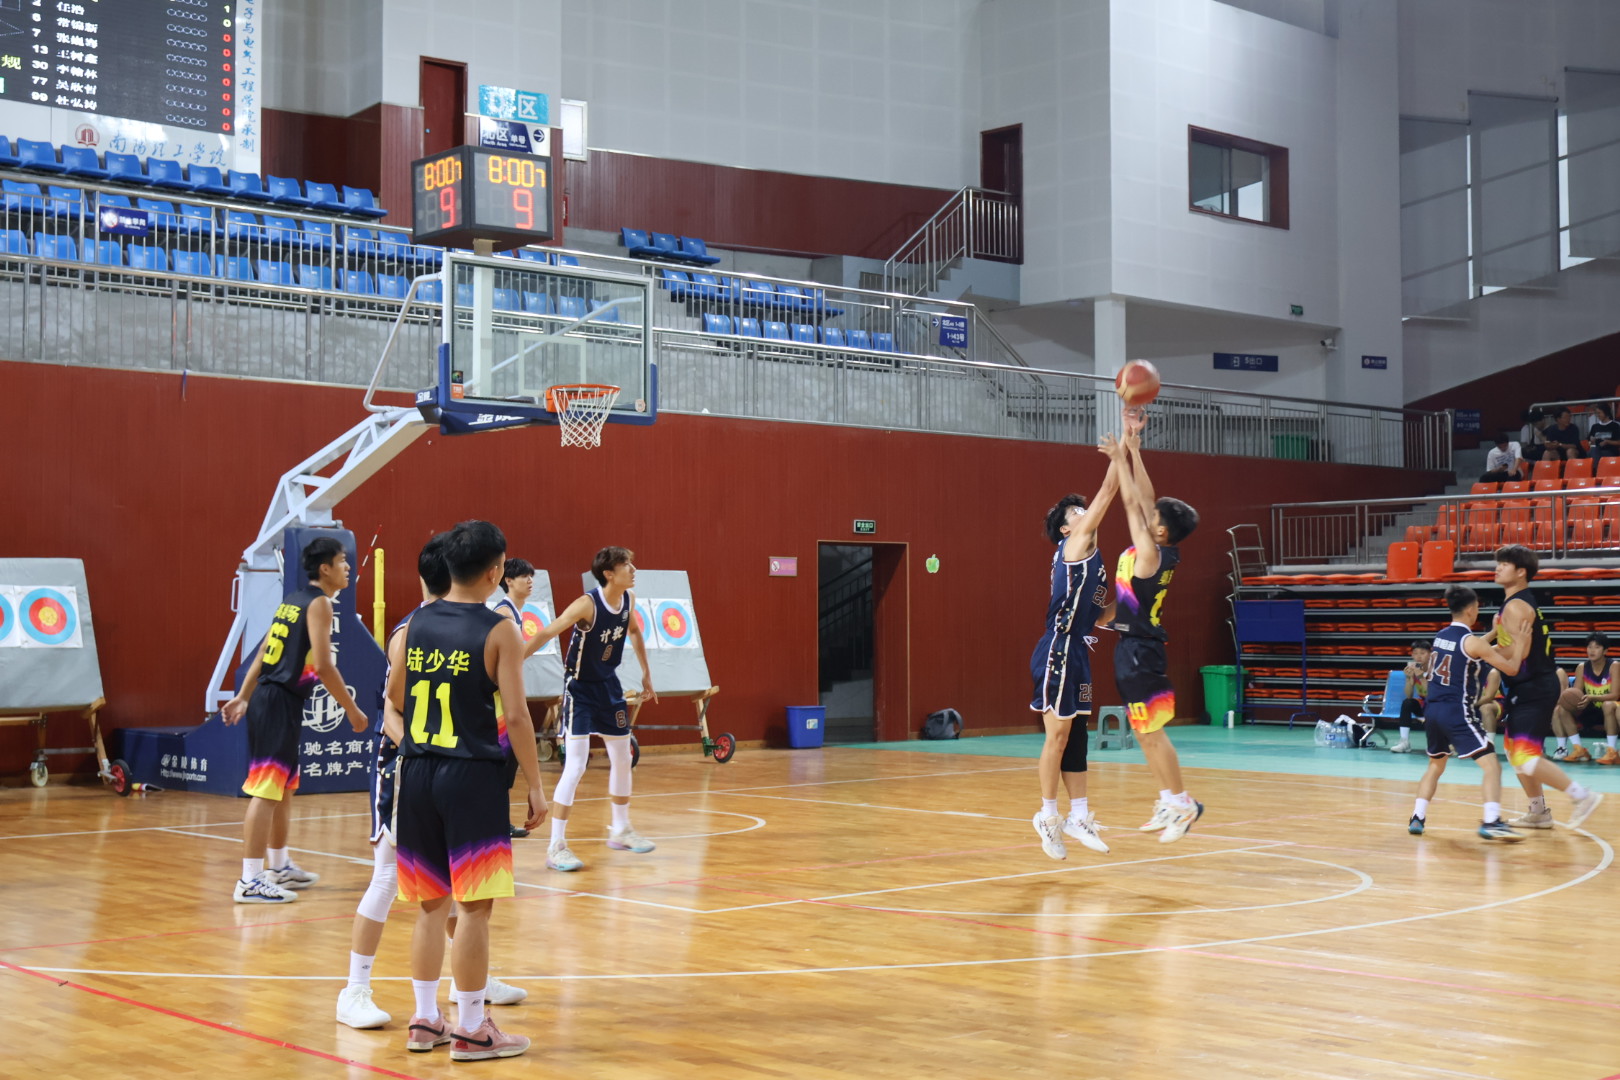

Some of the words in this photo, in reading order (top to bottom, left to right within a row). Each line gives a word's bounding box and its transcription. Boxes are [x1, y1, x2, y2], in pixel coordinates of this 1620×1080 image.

[222, 18, 232, 27] 0
[223, 5, 230, 13] 1
[32, 28, 41, 37] 7
[222, 63, 232, 71] 0
[222, 34, 232, 42] 0
[222, 49, 232, 57] 0
[32, 44, 48, 54] 13
[222, 78, 231, 86] 0
[32, 60, 48, 70] 30
[222, 93, 231, 101] 0
[31, 91, 48, 102] 99
[222, 123, 231, 131] 0
[32, 76, 48, 85] 77
[222, 108, 231, 116] 0
[440, 187, 456, 228] 9
[513, 188, 533, 230] 9
[407, 647, 470, 676] 陆少华
[1426, 650, 1453, 687] 14
[410, 680, 459, 748] 11
[615, 709, 627, 729] 8
[1127, 701, 1149, 721] 10
